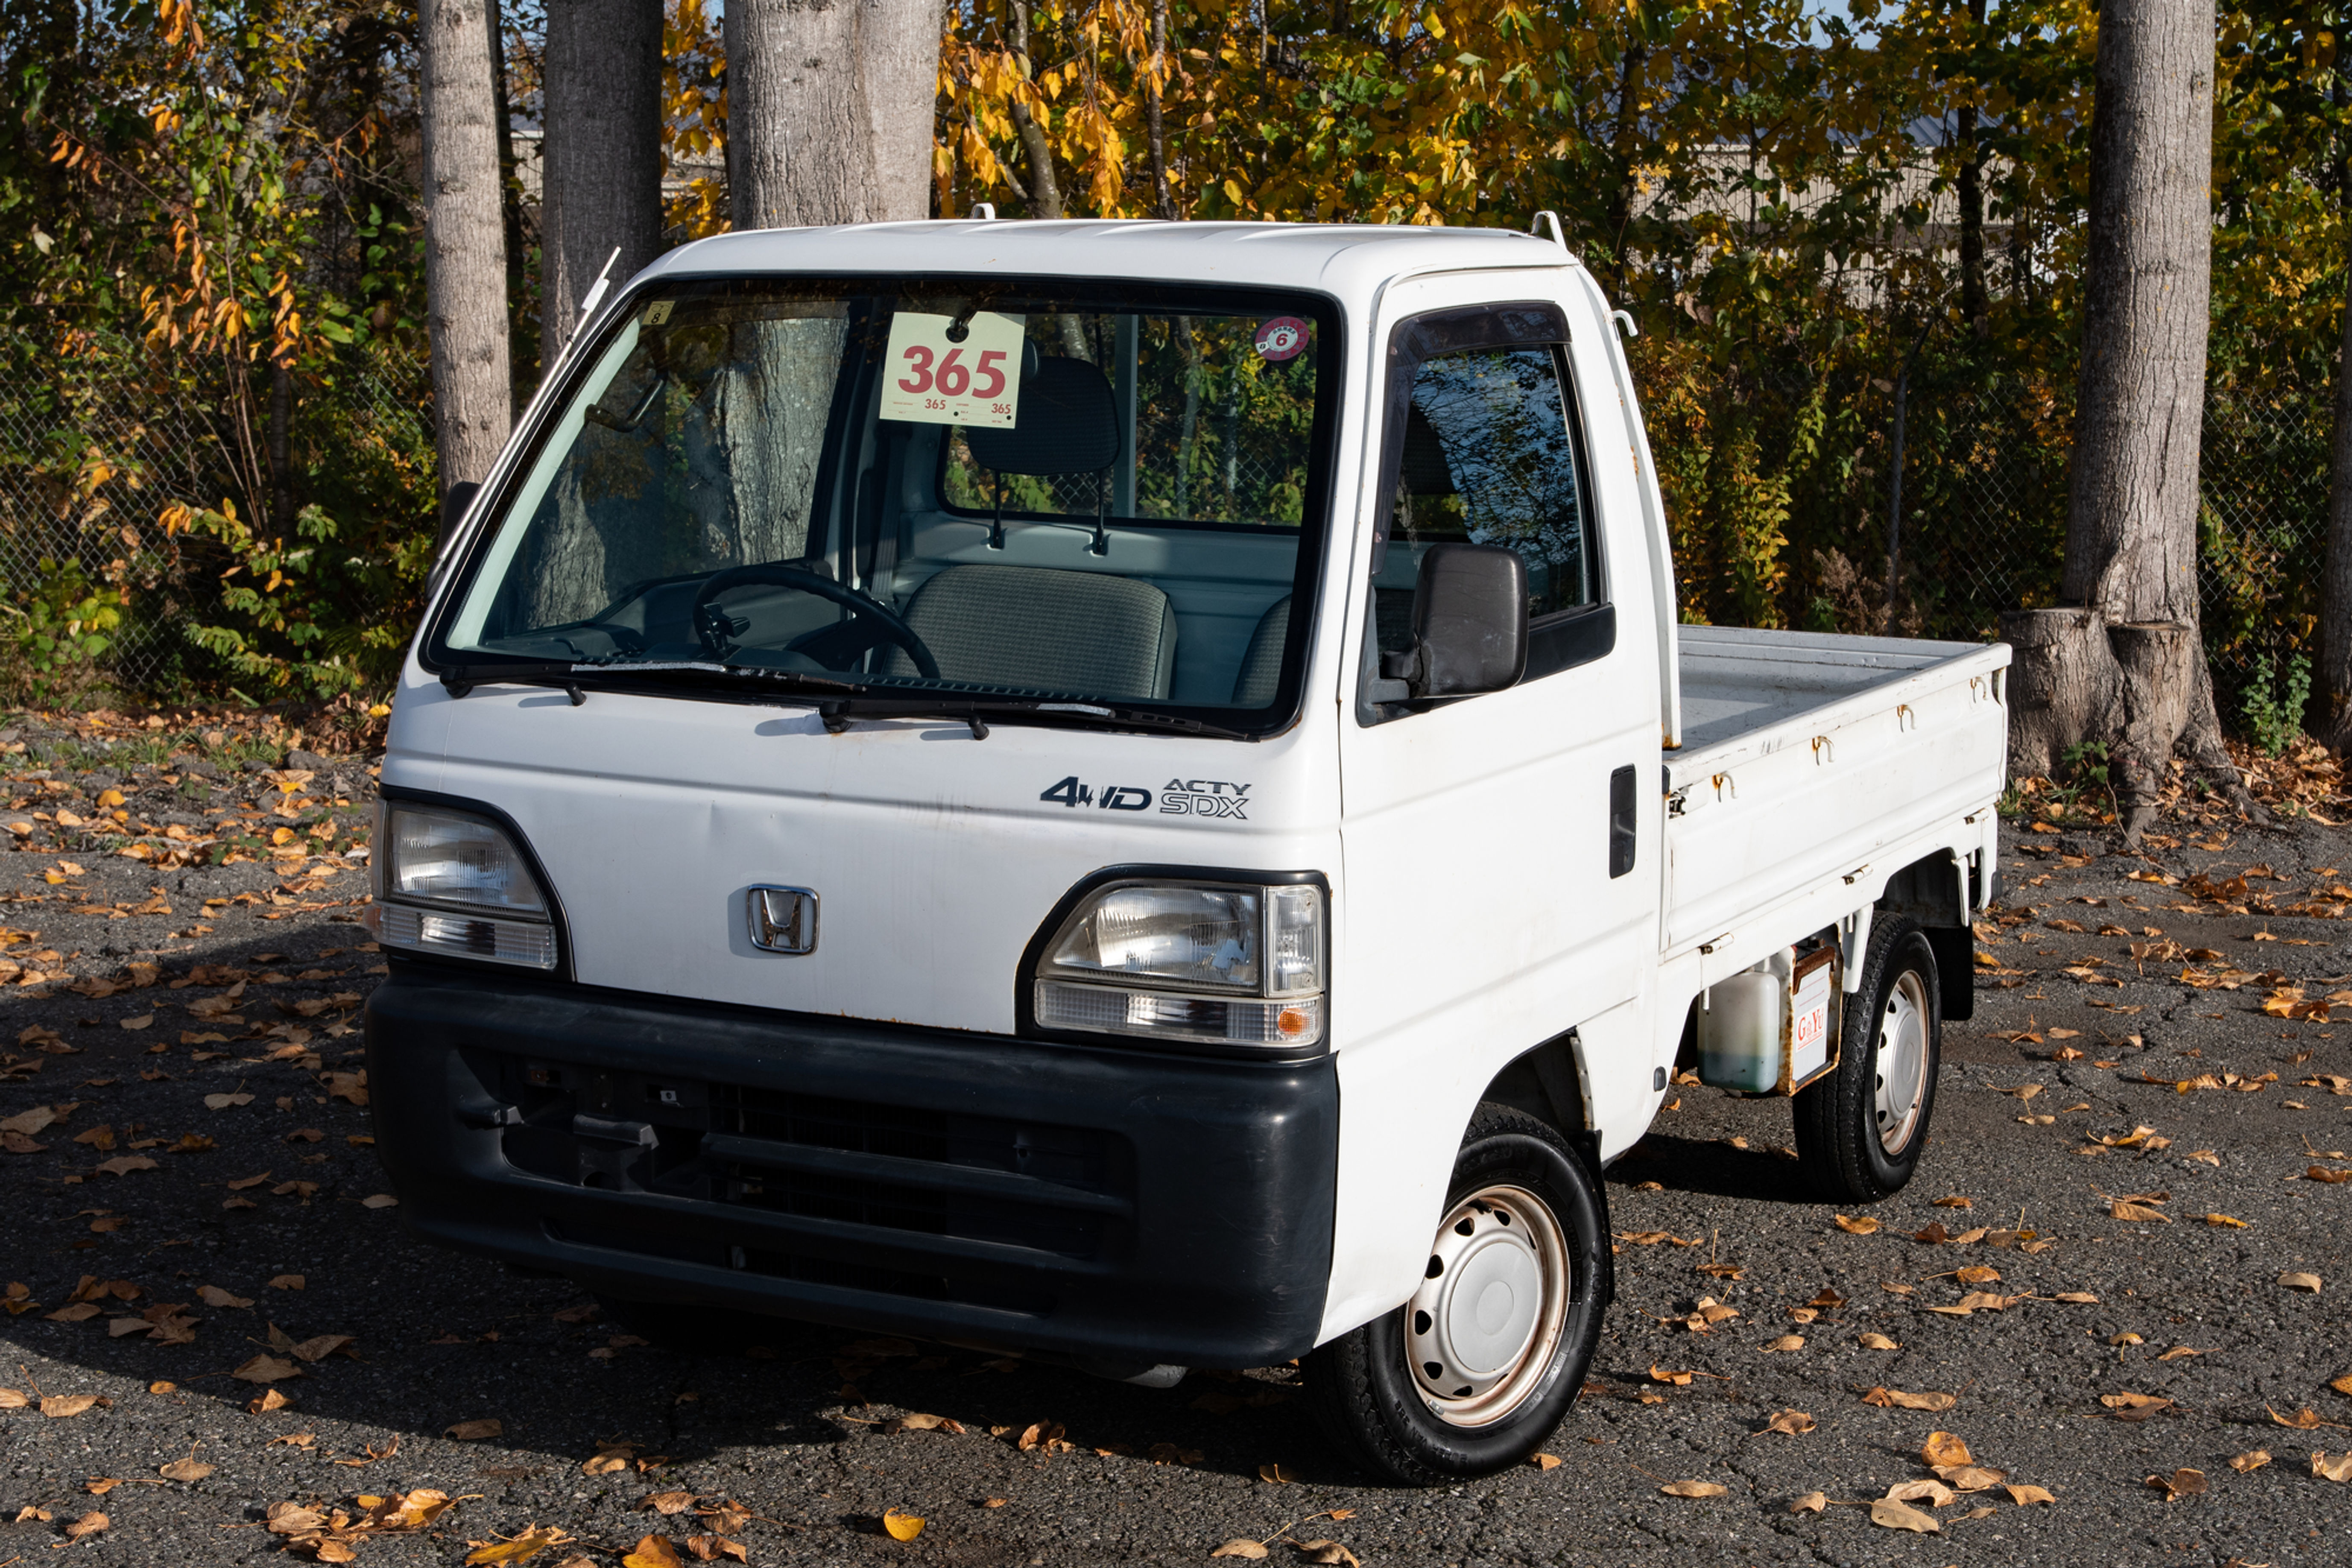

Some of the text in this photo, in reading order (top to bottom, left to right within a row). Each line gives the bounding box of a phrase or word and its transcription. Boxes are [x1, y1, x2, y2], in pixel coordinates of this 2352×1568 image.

[651, 313, 661, 324] 8
[1276, 333, 1288, 346] 6
[898, 345, 1006, 399] 365
[924, 398, 946, 410] 365
[991, 403, 1011, 415] 365
[1040, 776, 1153, 810] 4WD
[1163, 778, 1252, 796] ACTY
[1159, 793, 1250, 820] SDX
